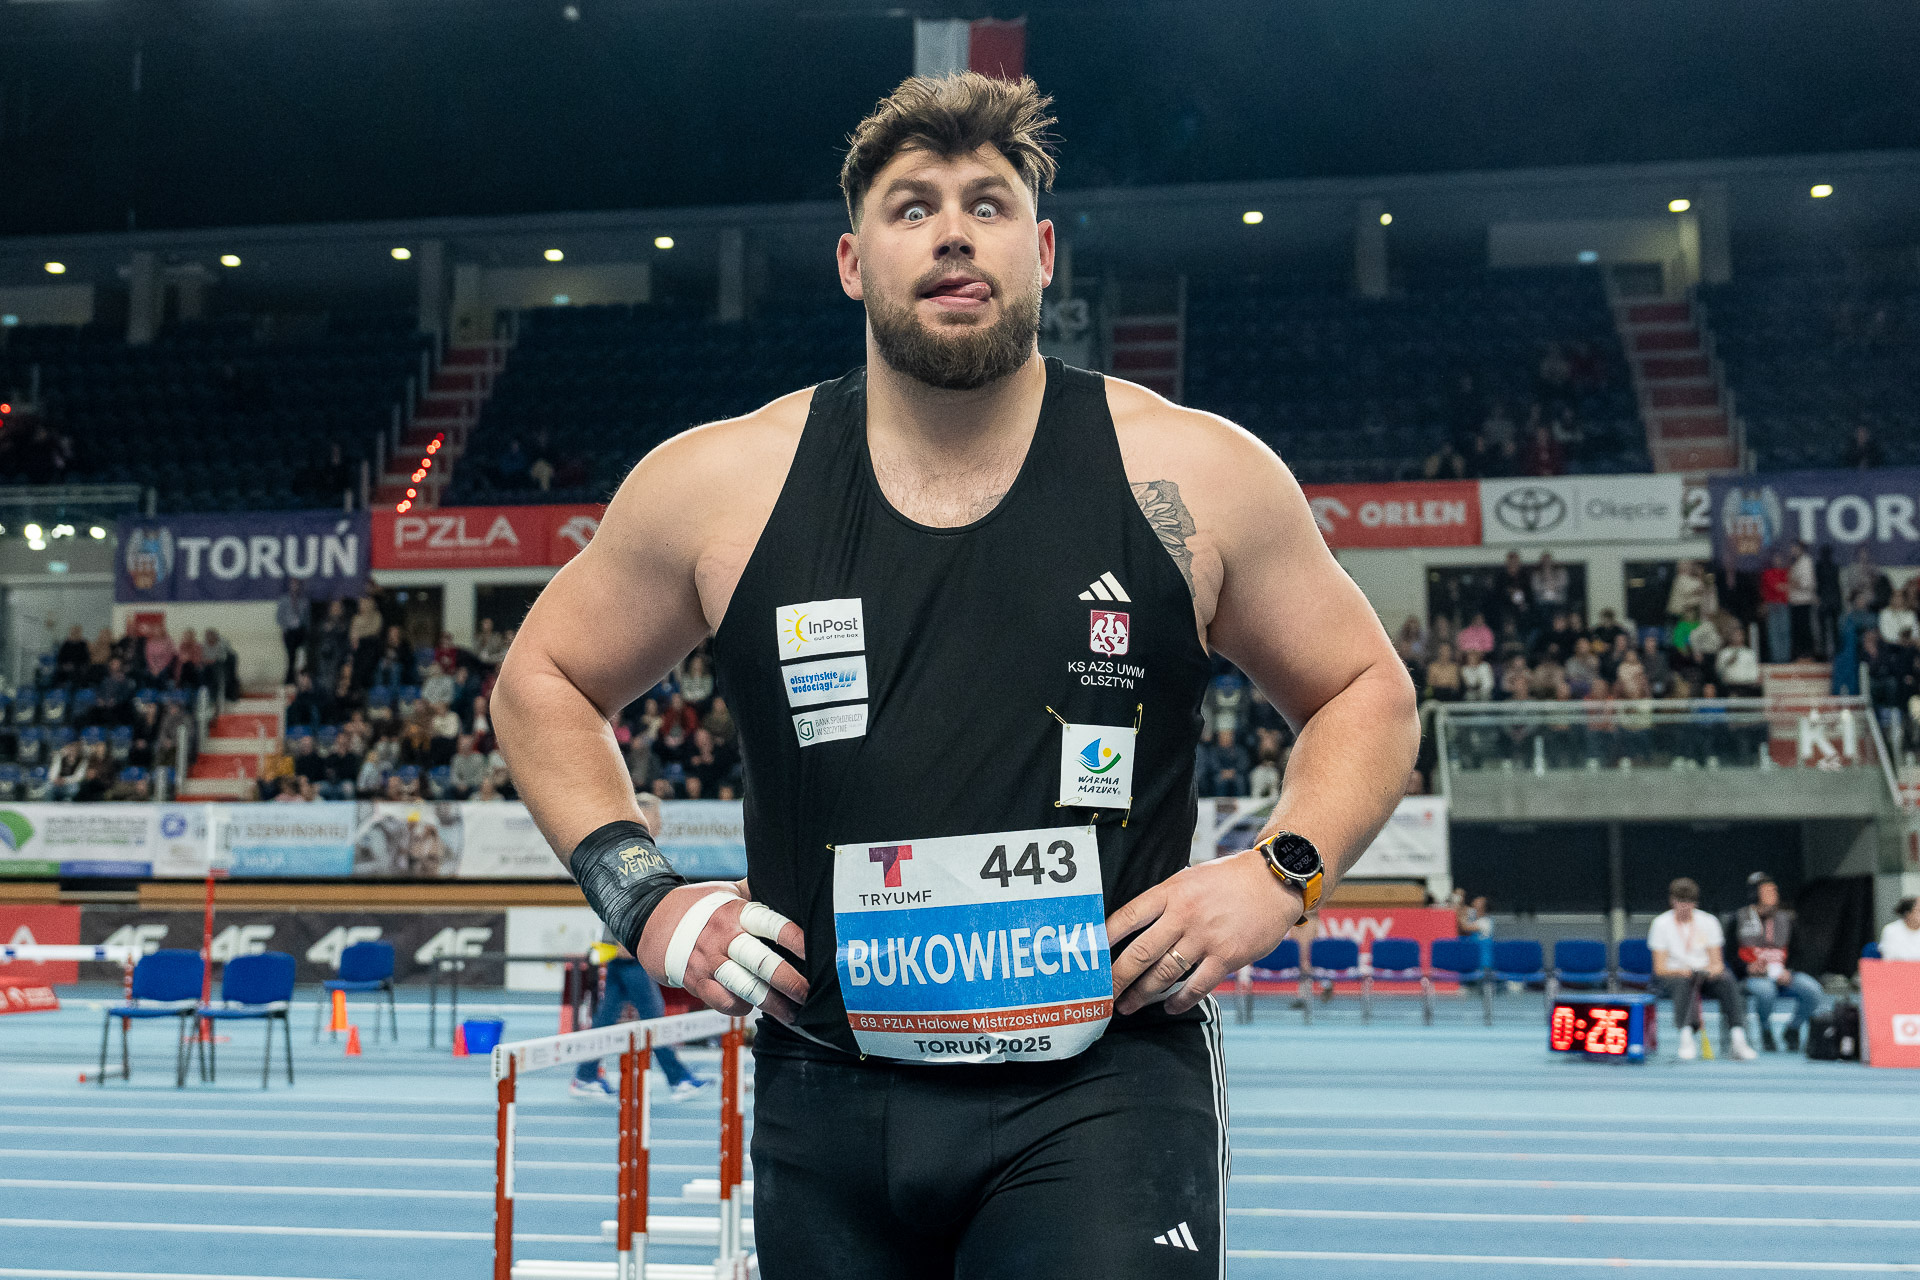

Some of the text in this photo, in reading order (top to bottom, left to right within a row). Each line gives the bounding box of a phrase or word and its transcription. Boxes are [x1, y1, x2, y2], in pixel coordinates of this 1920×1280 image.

[1359, 501, 1467, 527] ORLEN
[395, 516, 519, 548] PZLA
[177, 520, 359, 581] TORUŃ
[808, 617, 859, 634] InPost
[790, 670, 838, 685] olsztyńskie
[1068, 661, 1145, 679] KS AZS UWM
[1080, 675, 1134, 690] OLSZTYN
[815, 717, 830, 727] BANK
[1078, 775, 1120, 785] WARMIA
[618, 854, 664, 877] VENUM
[979, 840, 1078, 888] 443
[859, 889, 932, 907] TRYUMF
[847, 922, 1100, 987] BUKOWIECKI
[860, 1003, 1105, 1030] 69. PZLA Halowe Mistrzostwa Polski
[1552, 1006, 1629, 1055] 0:26
[914, 1035, 1052, 1055] TORUŃ 2025
